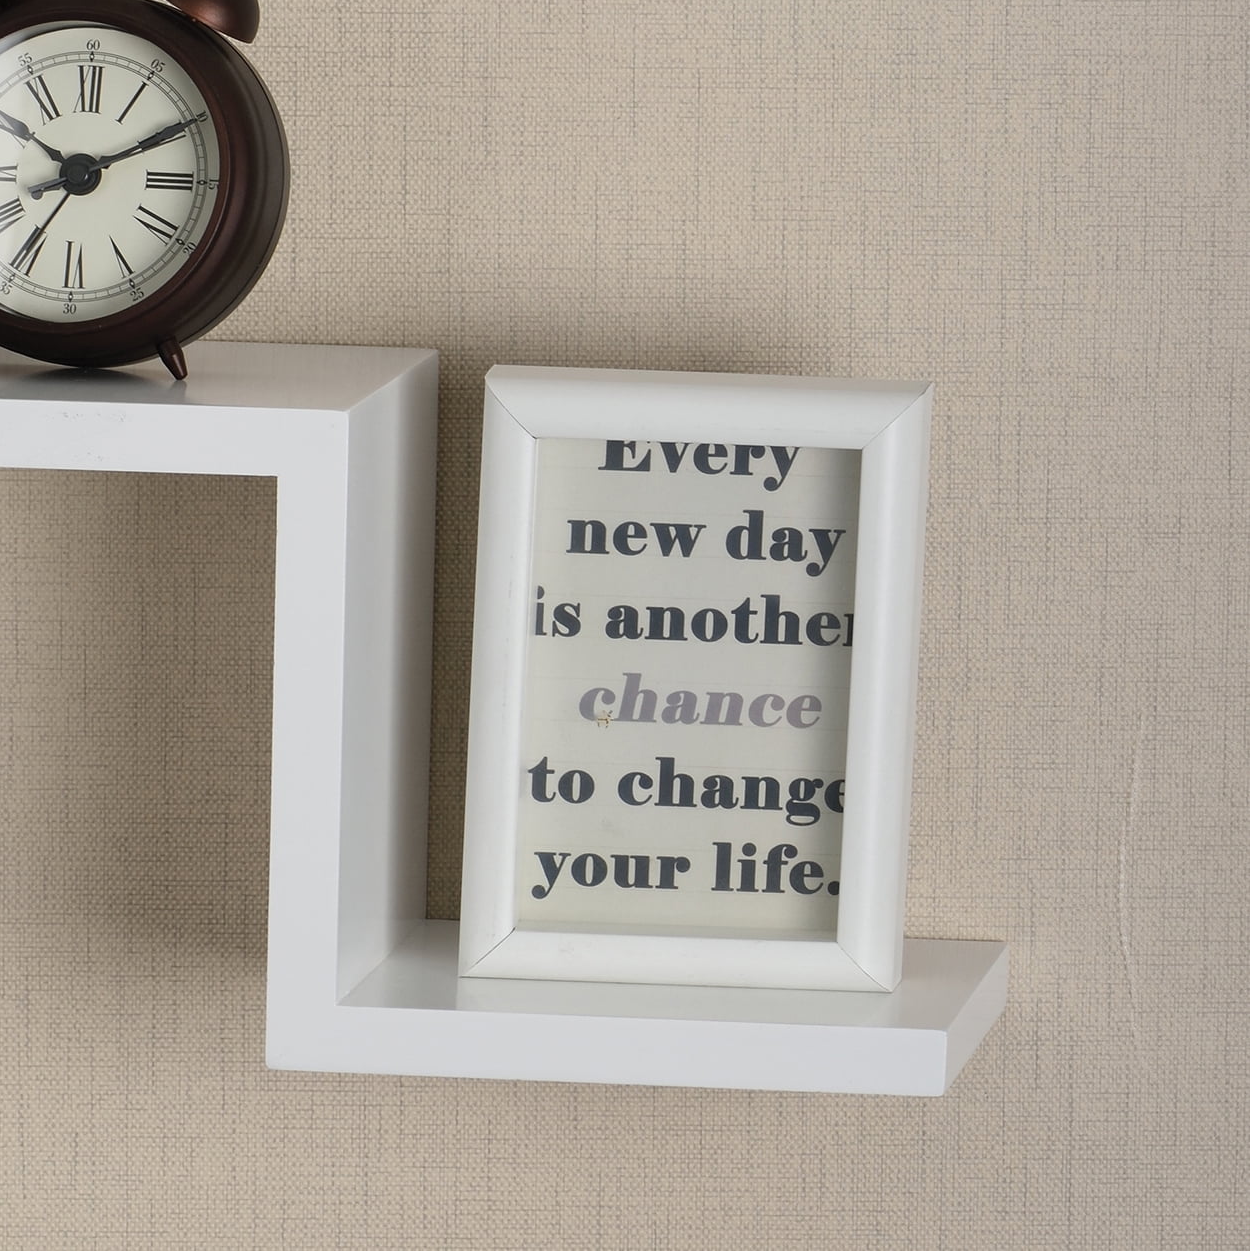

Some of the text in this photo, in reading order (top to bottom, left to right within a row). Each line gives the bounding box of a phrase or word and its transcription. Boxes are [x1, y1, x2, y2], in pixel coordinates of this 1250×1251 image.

[17, 52, 33, 67] 55
[86, 39, 101, 51] 60
[150, 58, 166, 73] 05
[72, 65, 105, 114] XII
[144, 169, 195, 192] III
[62, 303, 77, 315] 30
[130, 287, 145, 302] 25
[597, 438, 801, 492] Every
[565, 509, 847, 578] new day
[534, 585, 582, 638] is
[578, 672, 823, 729] chance
[527, 755, 596, 805] to
[530, 841, 840, 900] your life.
